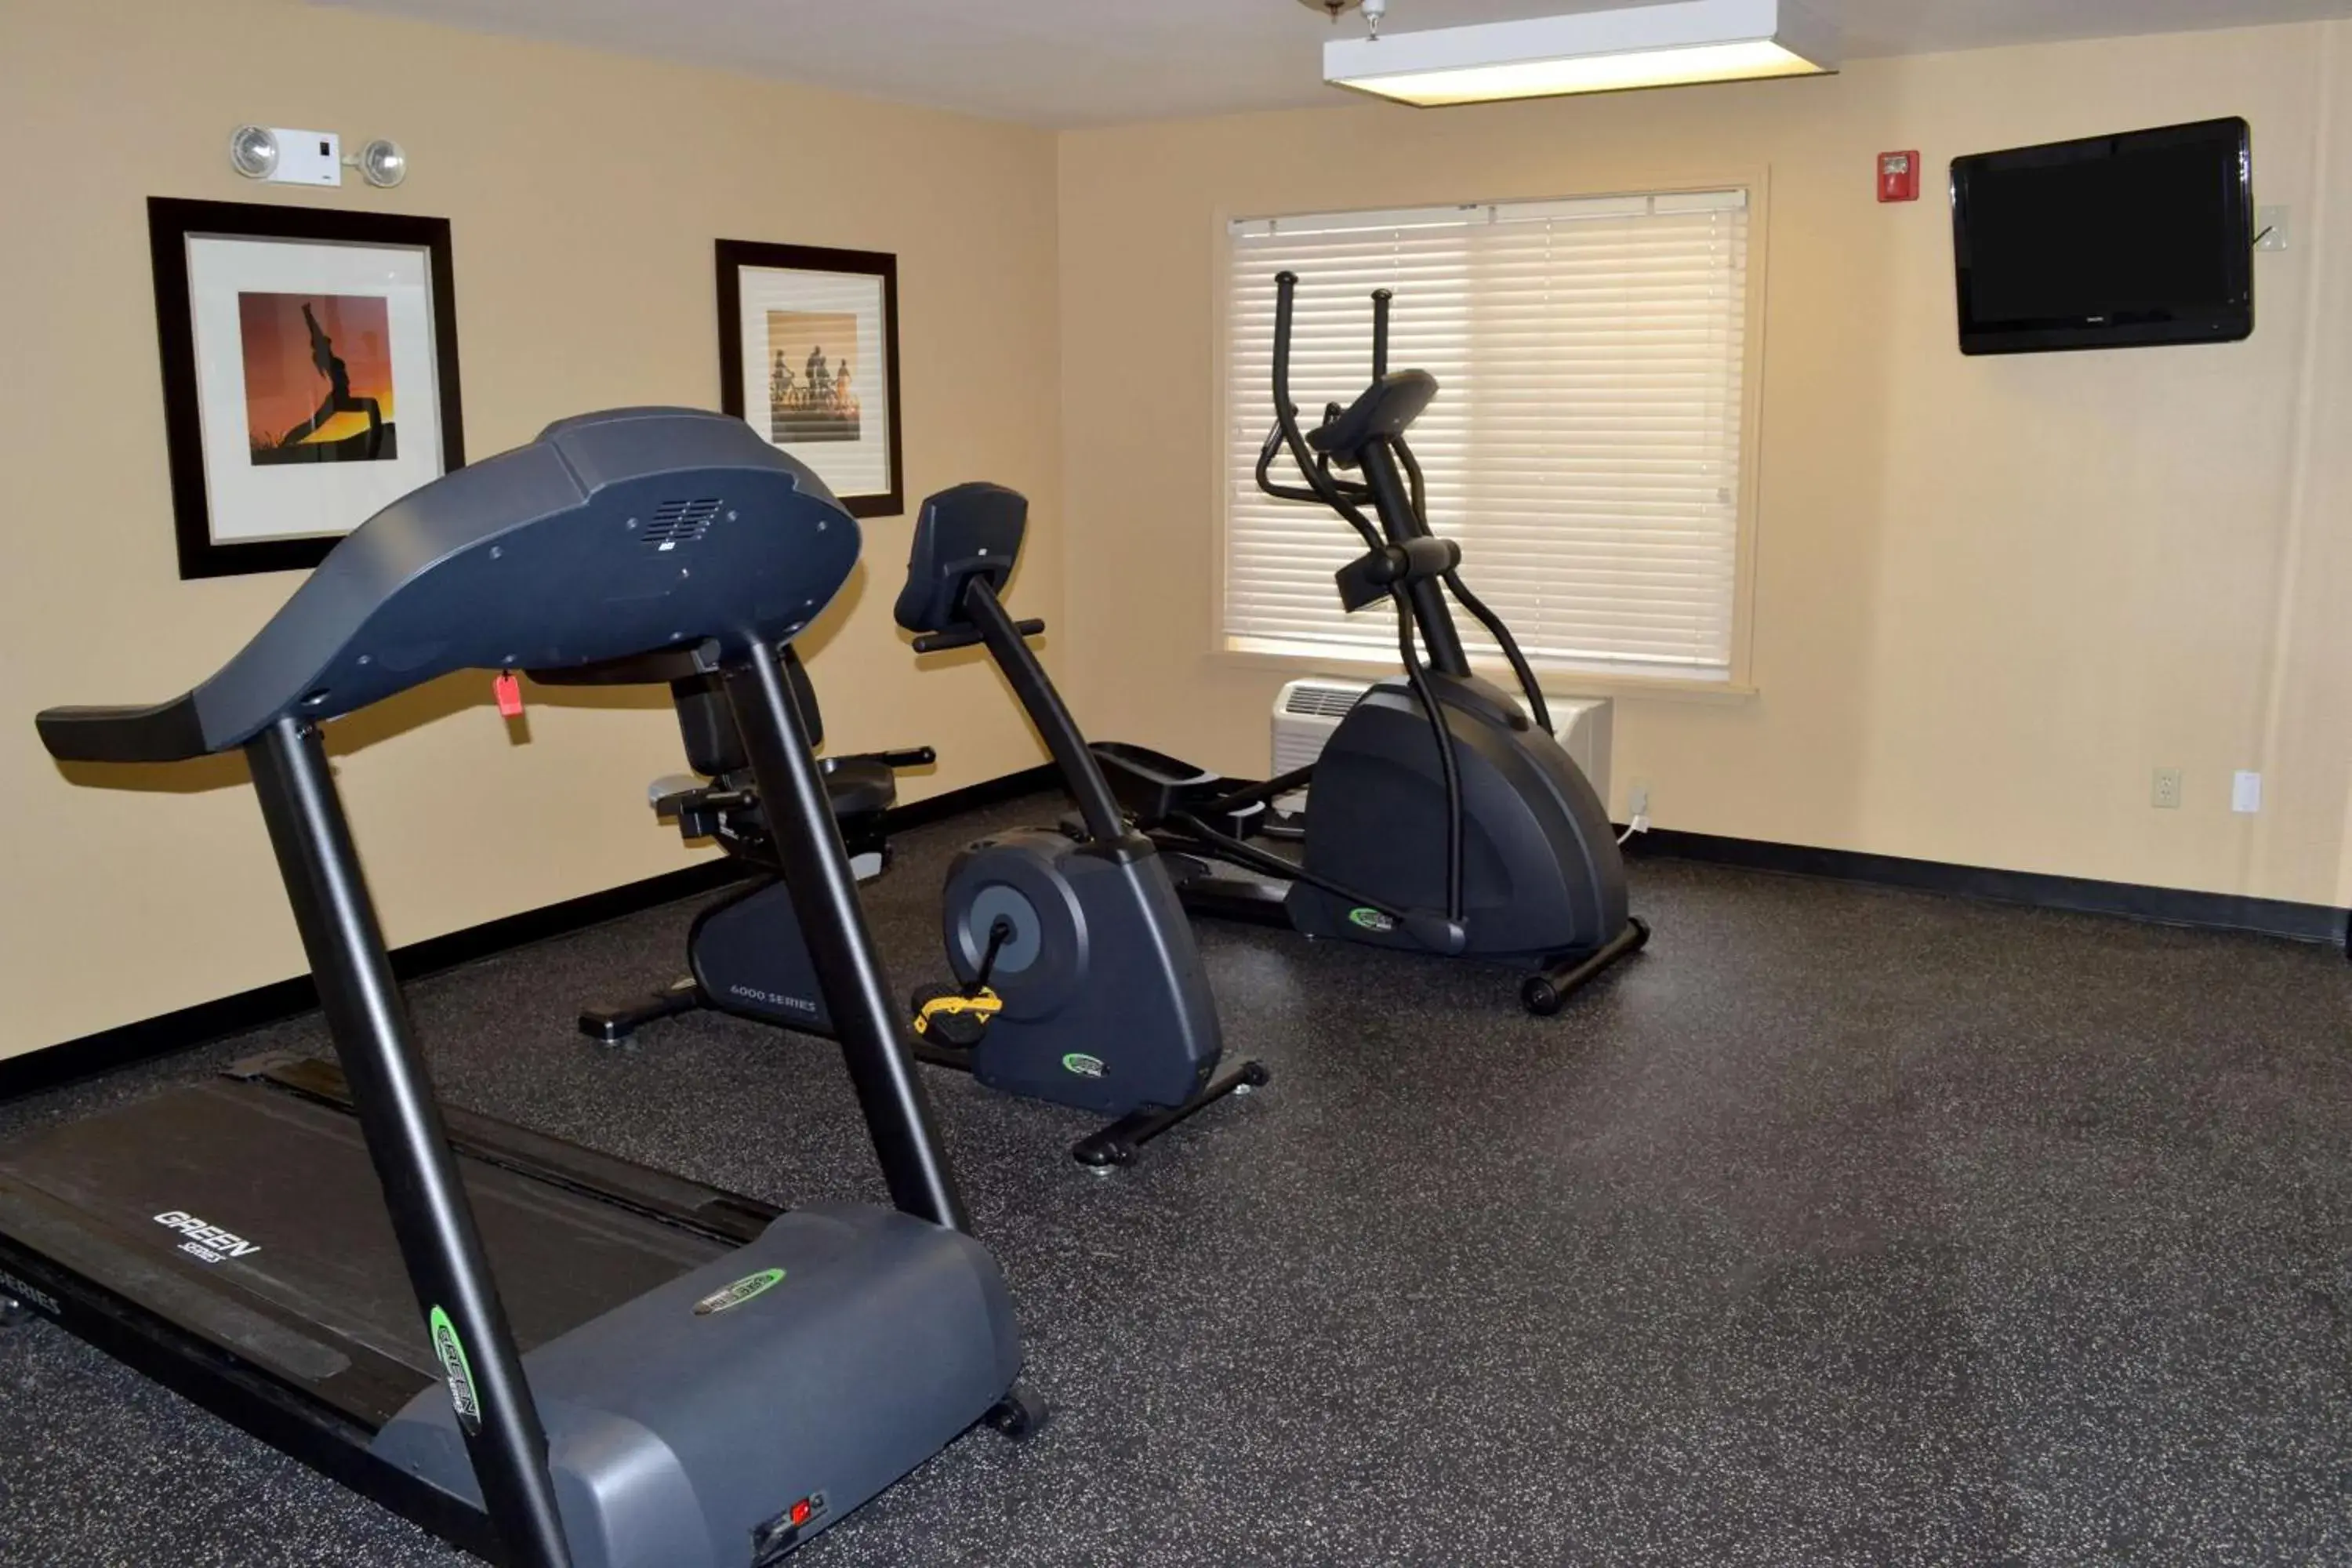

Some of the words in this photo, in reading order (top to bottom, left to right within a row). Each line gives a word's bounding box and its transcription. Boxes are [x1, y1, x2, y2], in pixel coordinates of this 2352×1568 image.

[730, 985, 765, 1001] 6000
[768, 993, 816, 1012] SERIES
[153, 1210, 261, 1257] GREEN
[0, 1269, 61, 1315] ERIES
[438, 1324, 479, 1417] GREEN
